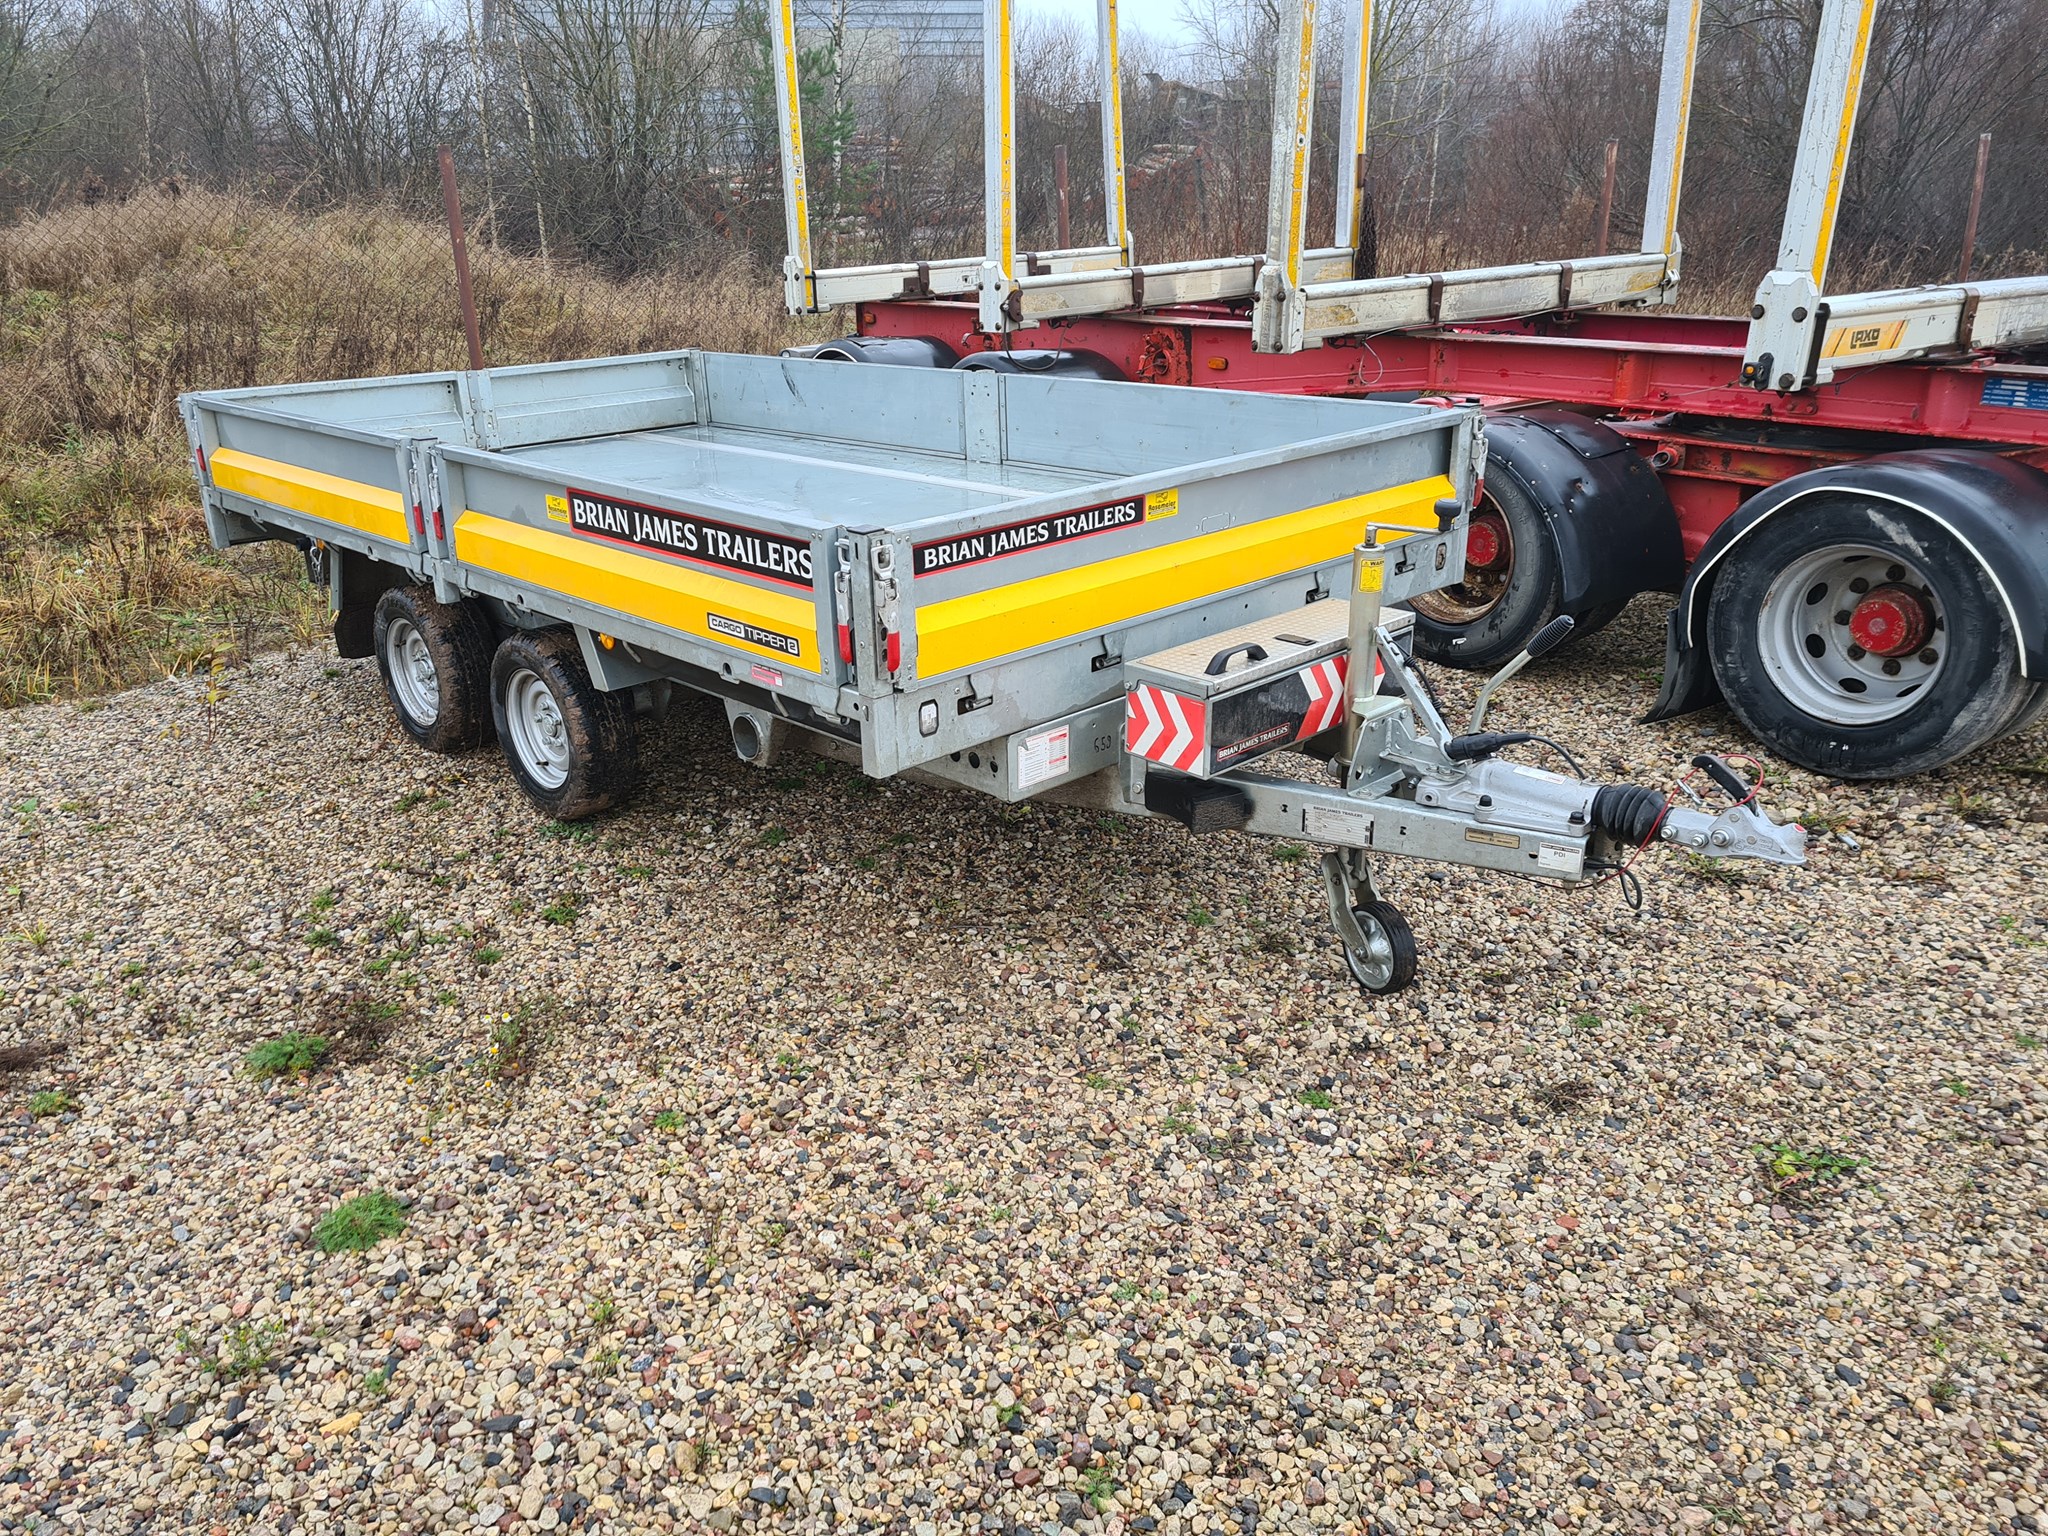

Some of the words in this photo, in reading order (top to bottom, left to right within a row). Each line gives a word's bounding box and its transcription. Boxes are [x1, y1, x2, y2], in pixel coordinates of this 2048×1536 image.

[572, 498, 630, 536] BRIAN
[633, 511, 698, 551] JAMES
[702, 527, 813, 579] TRAILERS
[923, 536, 985, 570] BRIAN
[987, 522, 1049, 557] JAMES
[1054, 502, 1136, 538] TRAILERS
[711, 618, 742, 634] CARGO
[745, 626, 786, 650] TIPPER
[789, 640, 797, 651] 2
[1219, 745, 1239, 758] BRIAN
[1239, 737, 1259, 752] JAMES
[1260, 725, 1288, 742] TRAILERS
